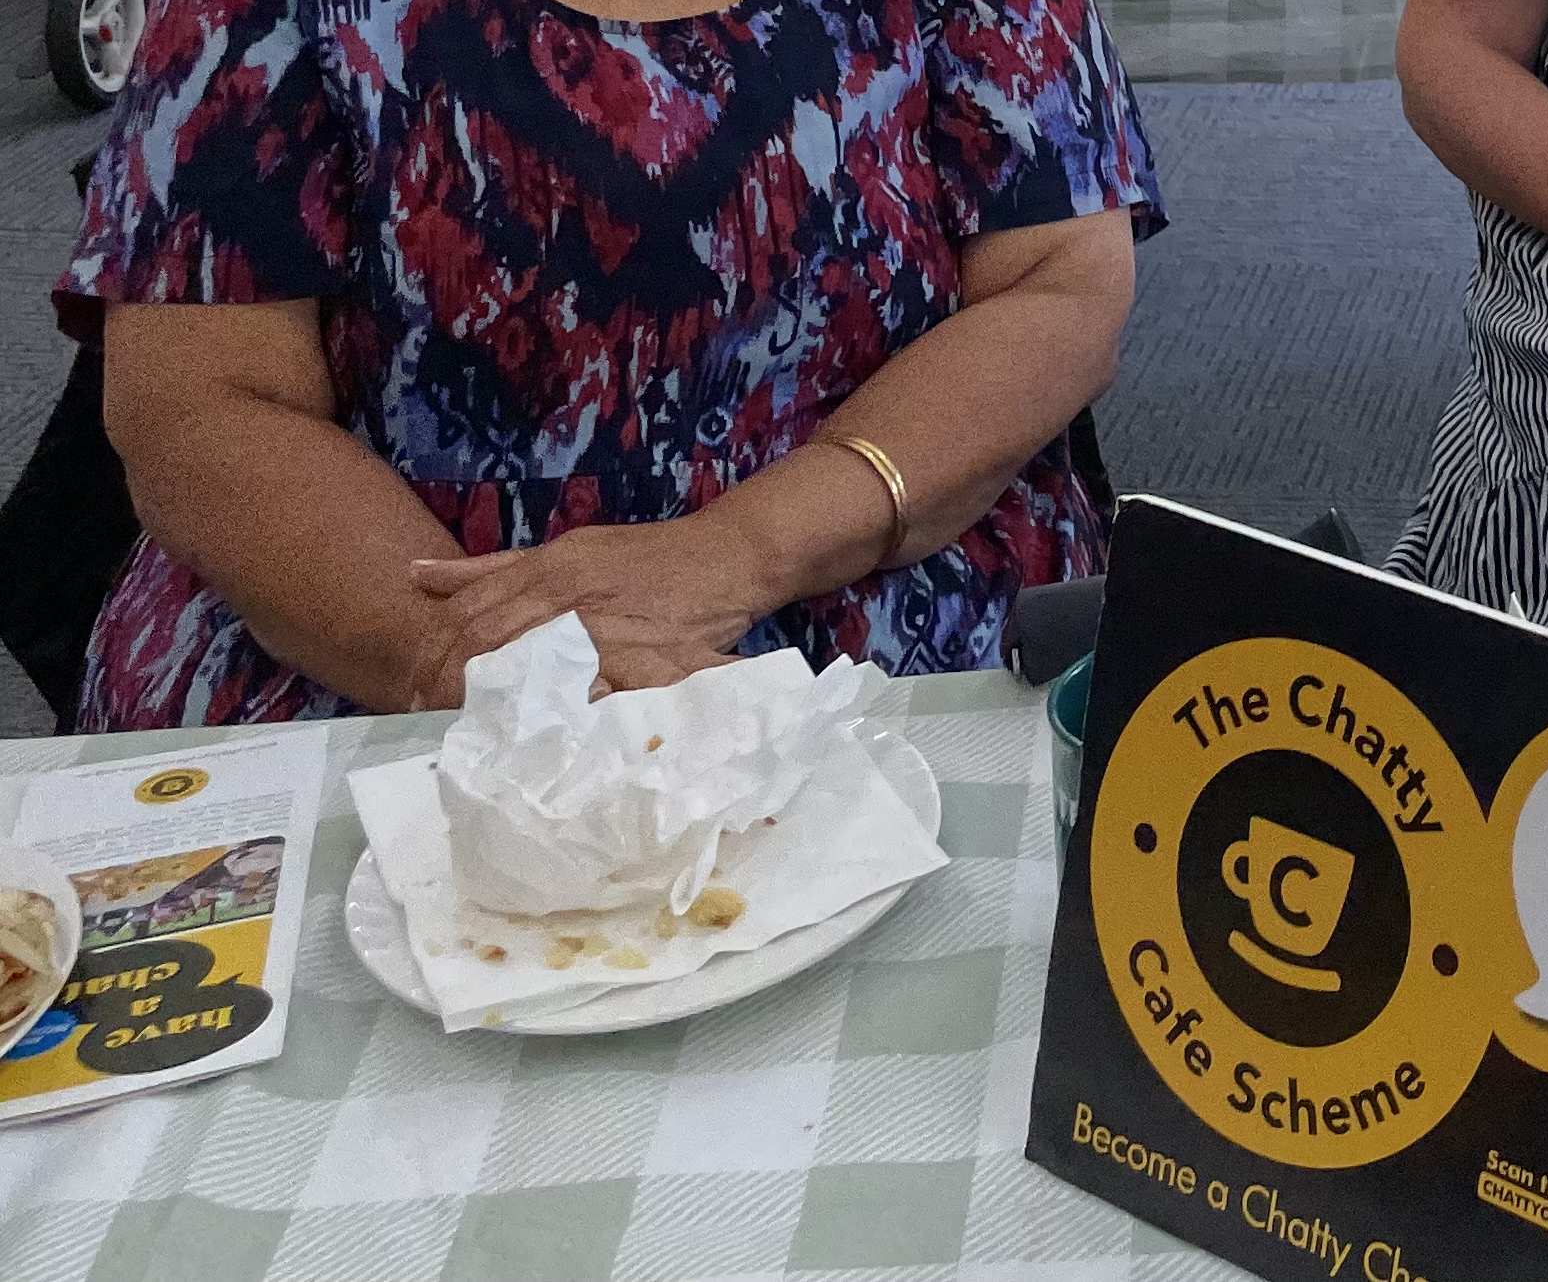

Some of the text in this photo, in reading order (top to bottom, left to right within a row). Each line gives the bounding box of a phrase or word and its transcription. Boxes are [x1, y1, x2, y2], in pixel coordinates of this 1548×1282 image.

[1173, 674, 1443, 834] The Chatty
[62, 960, 182, 1005] chat
[130, 993, 164, 1017] a
[104, 1004, 235, 1049] have
[1128, 939, 1426, 1136] Cafe Scheme
[1485, 1149, 1535, 1188] Scan
[1072, 1101, 1430, 1282] Become a Chatty Ch
